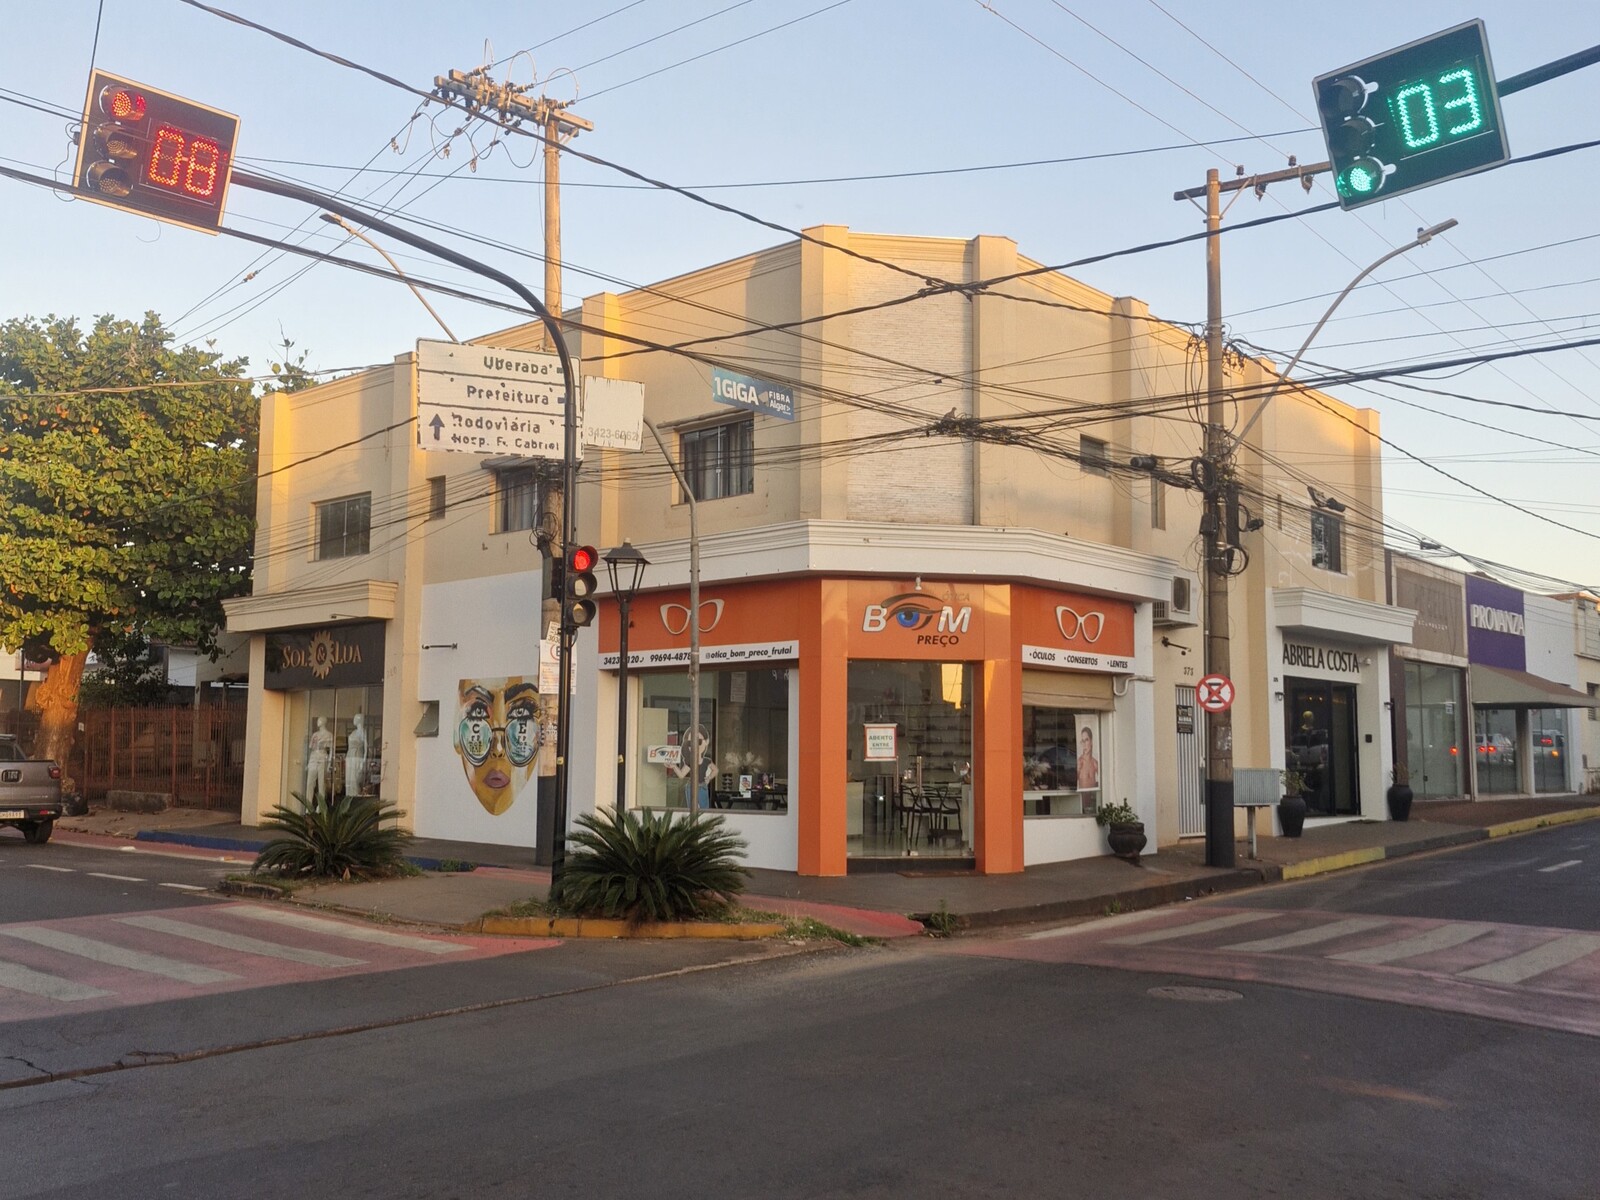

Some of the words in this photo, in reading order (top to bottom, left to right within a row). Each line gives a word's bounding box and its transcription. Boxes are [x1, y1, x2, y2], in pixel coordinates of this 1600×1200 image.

[1397, 69, 1483, 149] 03
[148, 129, 219, 196] 08
[466, 385, 549, 406] Prefeitura
[769, 391, 791, 403] FIBRA
[1470, 604, 1525, 637] PROVANZA
[917, 635, 959, 647] PREÇO
[1032, 649, 1056, 662] ÓCULOS
[1066, 655, 1098, 666] CONSERTOS
[1109, 660, 1128, 669] LENTES
[1326, 649, 1360, 674] COSTA
